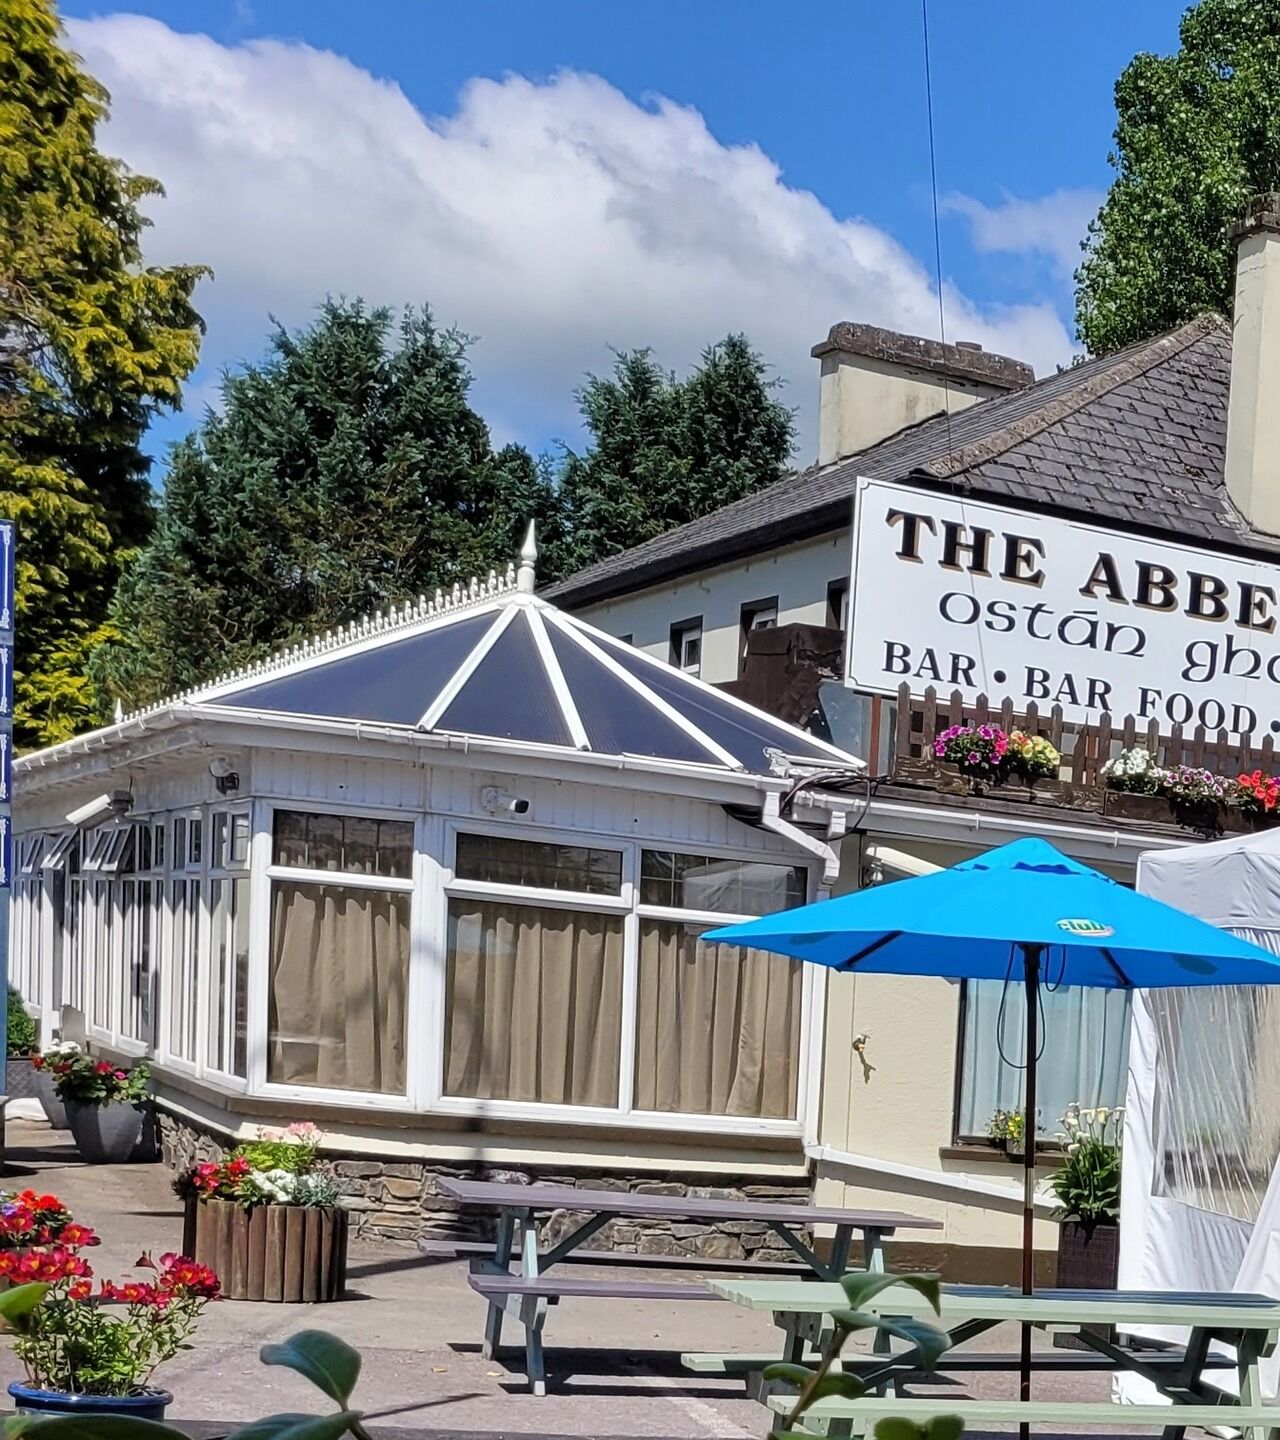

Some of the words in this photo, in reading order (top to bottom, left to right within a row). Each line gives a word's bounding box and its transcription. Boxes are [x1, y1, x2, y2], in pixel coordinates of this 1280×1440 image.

[885, 507, 1046, 589] THE
[881, 640, 977, 688] BAR
[1022, 665, 1112, 711] BAR
[1137, 686, 1257, 735] FOOD
